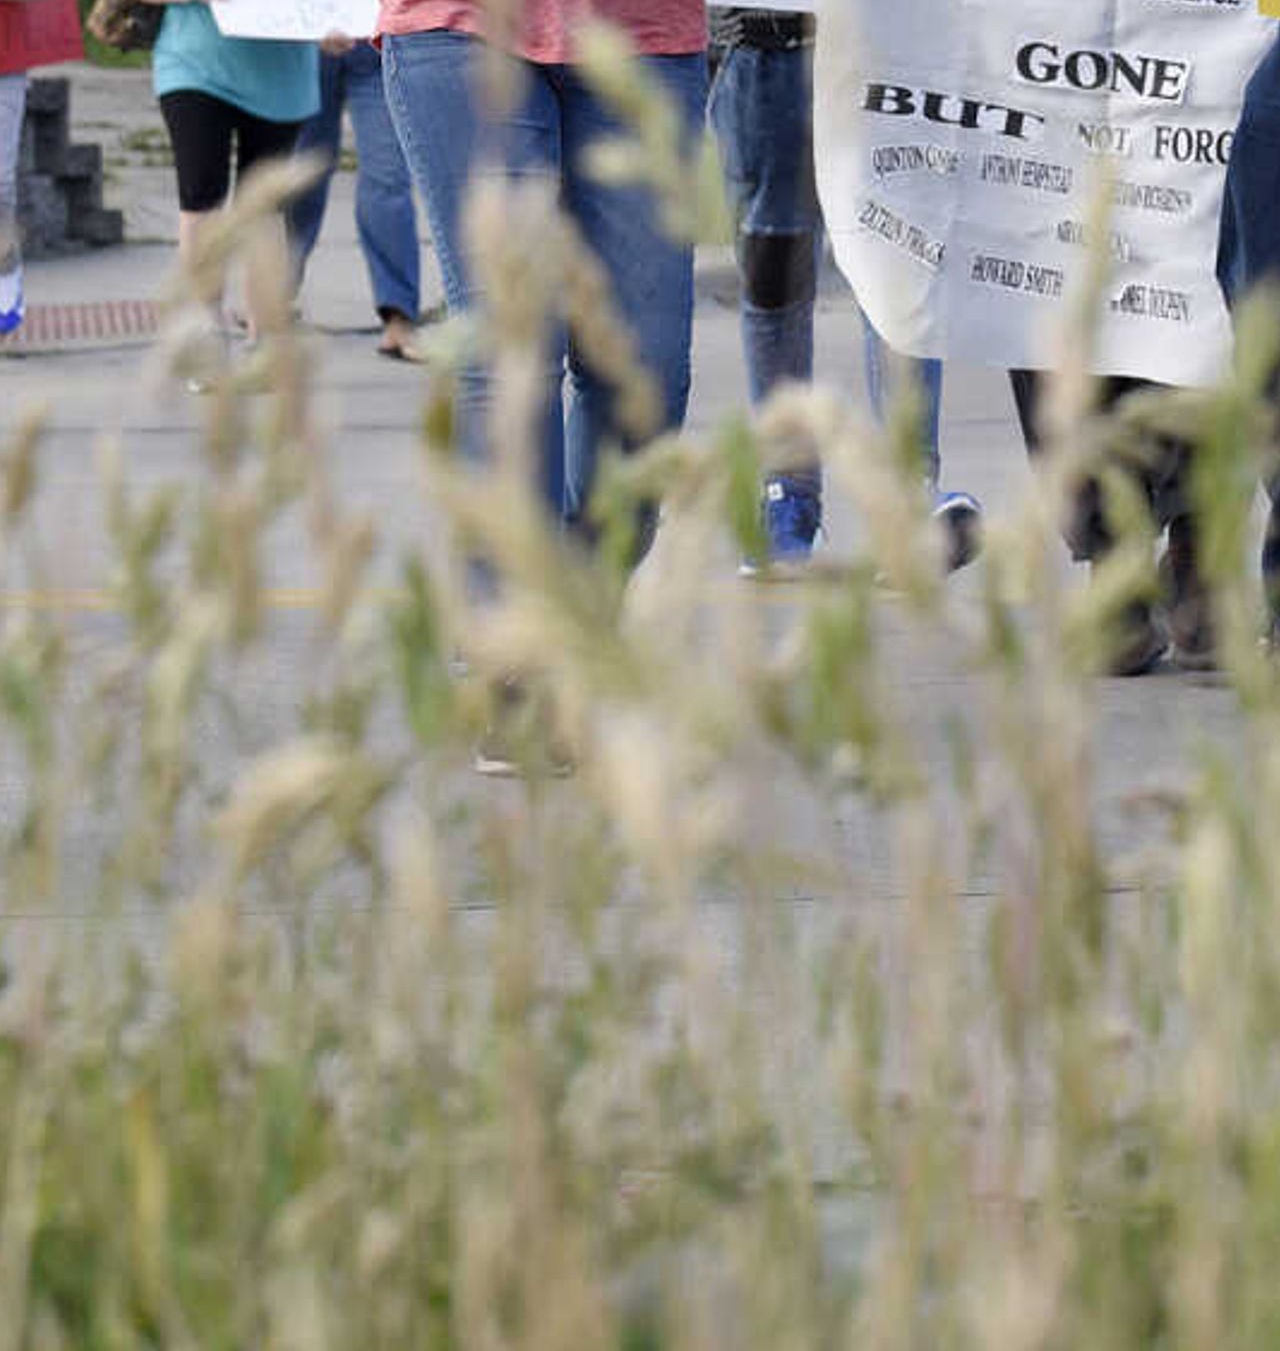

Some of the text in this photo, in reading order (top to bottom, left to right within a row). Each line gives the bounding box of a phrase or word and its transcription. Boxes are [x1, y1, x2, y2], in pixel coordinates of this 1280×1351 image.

[1017, 43, 1187, 101] GONE
[863, 82, 1045, 139] BUT
[1078, 123, 1131, 151] NOT
